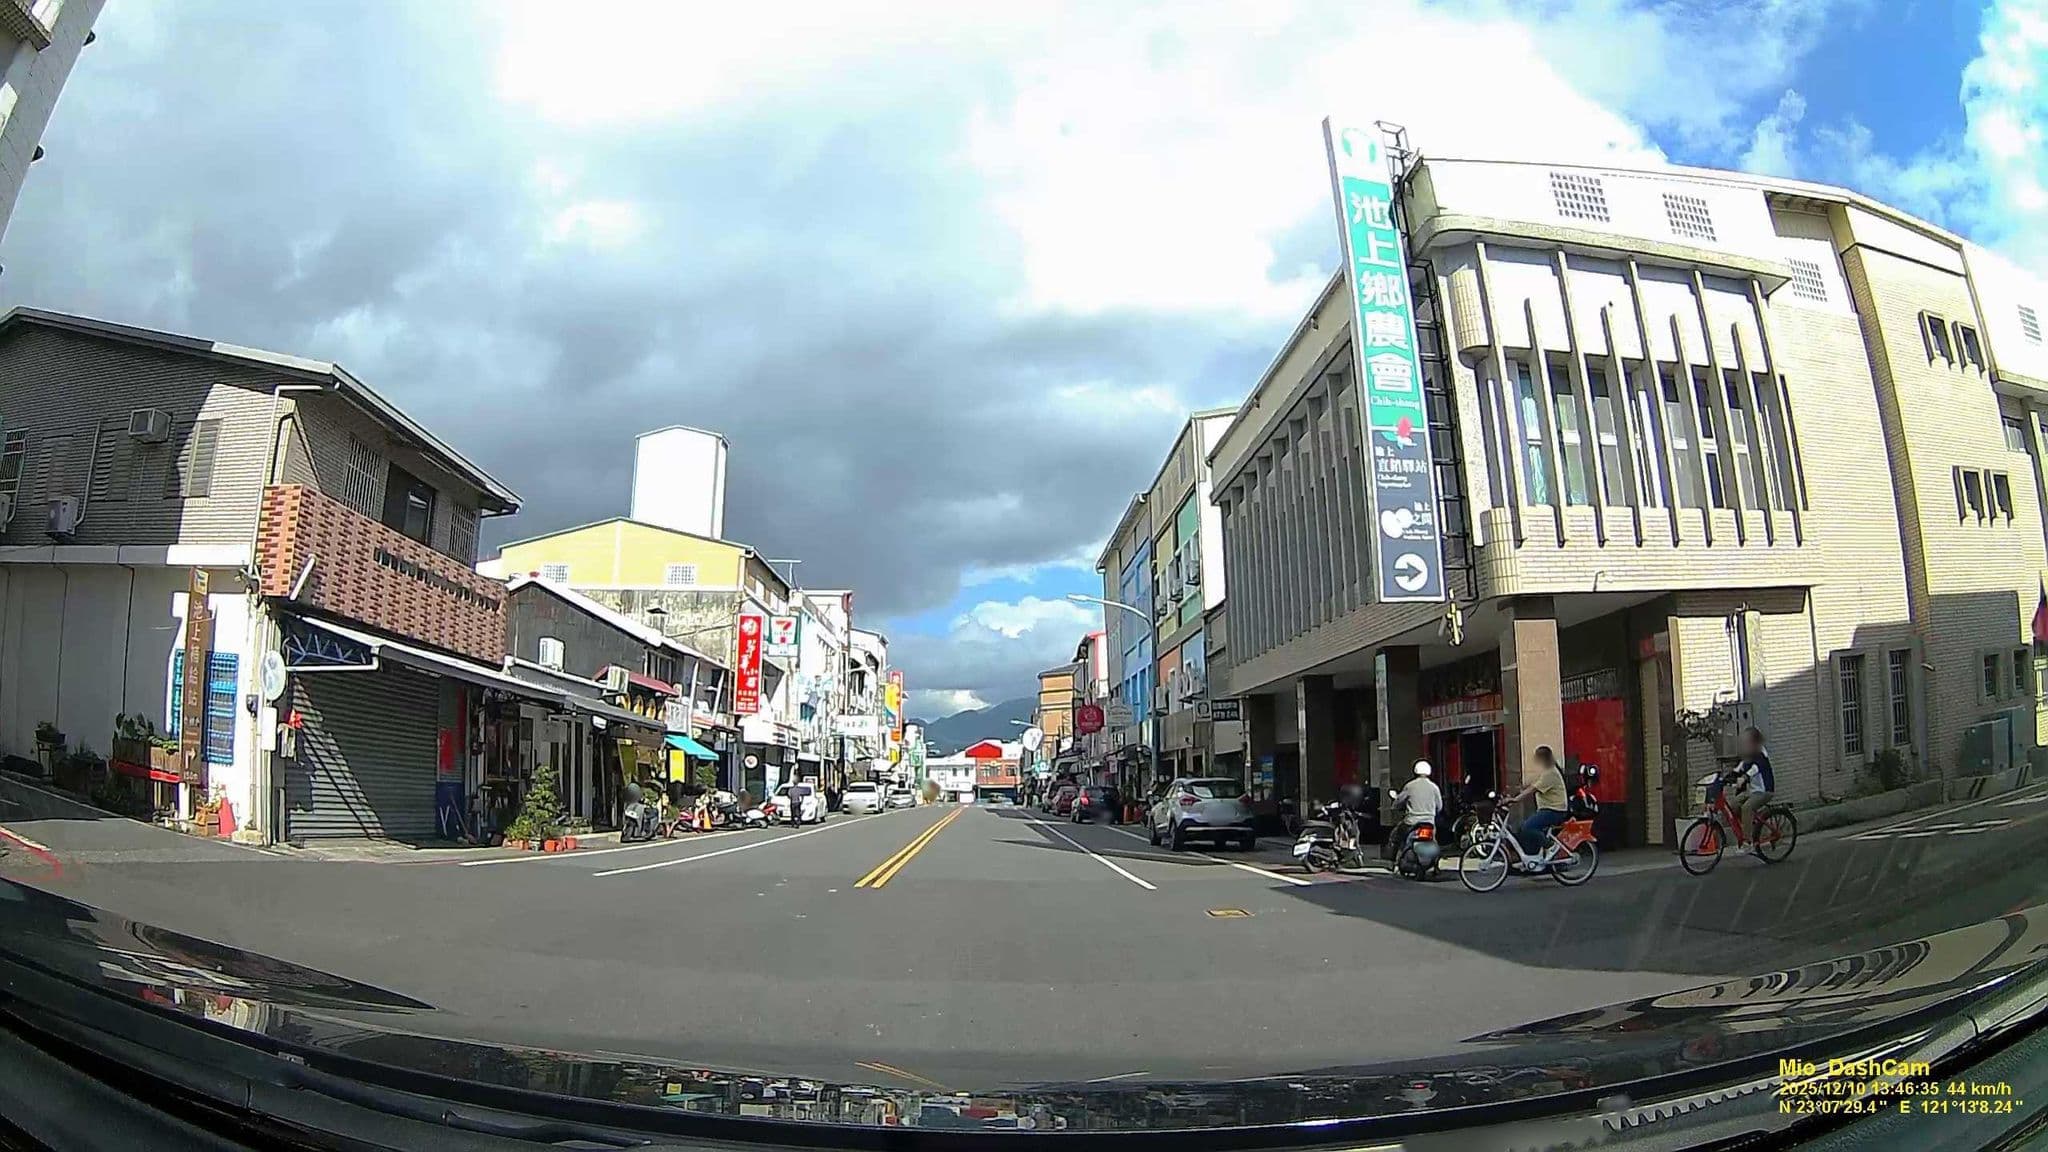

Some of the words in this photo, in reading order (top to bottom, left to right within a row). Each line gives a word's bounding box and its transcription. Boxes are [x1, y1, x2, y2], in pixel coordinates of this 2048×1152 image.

[1352, 192, 1412, 392] 池上鄉農會
